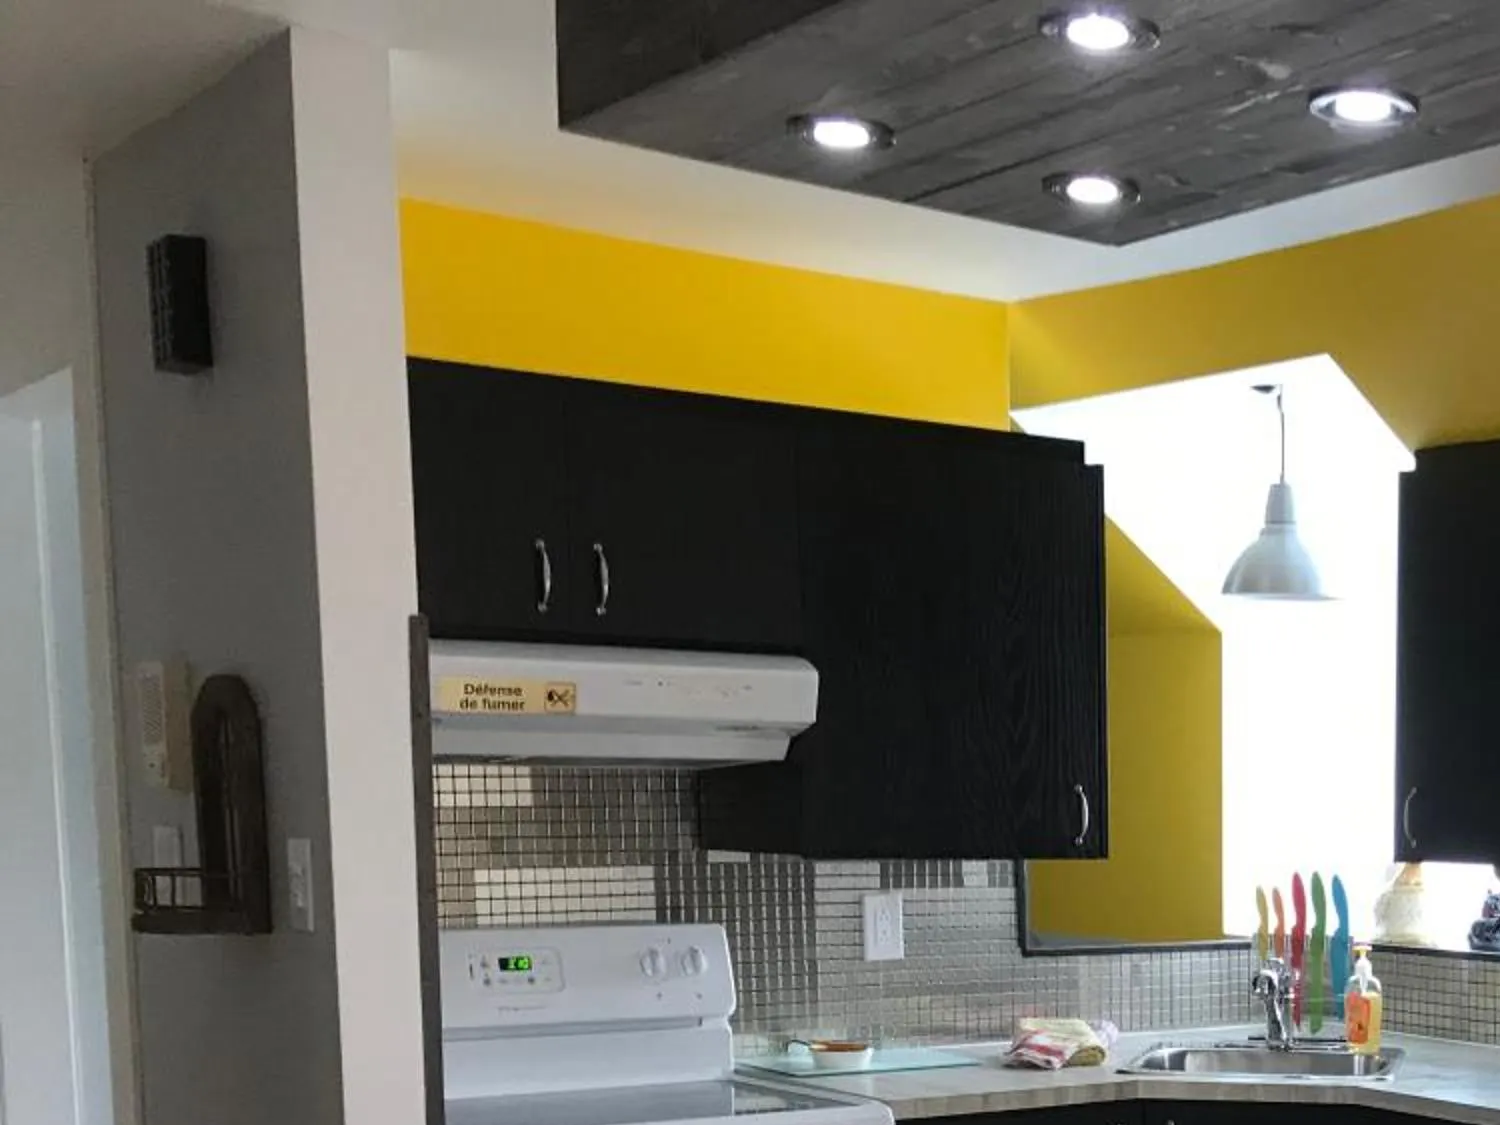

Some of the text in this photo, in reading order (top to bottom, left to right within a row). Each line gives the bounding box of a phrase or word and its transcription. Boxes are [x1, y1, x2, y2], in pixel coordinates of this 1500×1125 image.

[464, 683, 523, 697] Défense
[460, 697, 525, 711] de fumer
